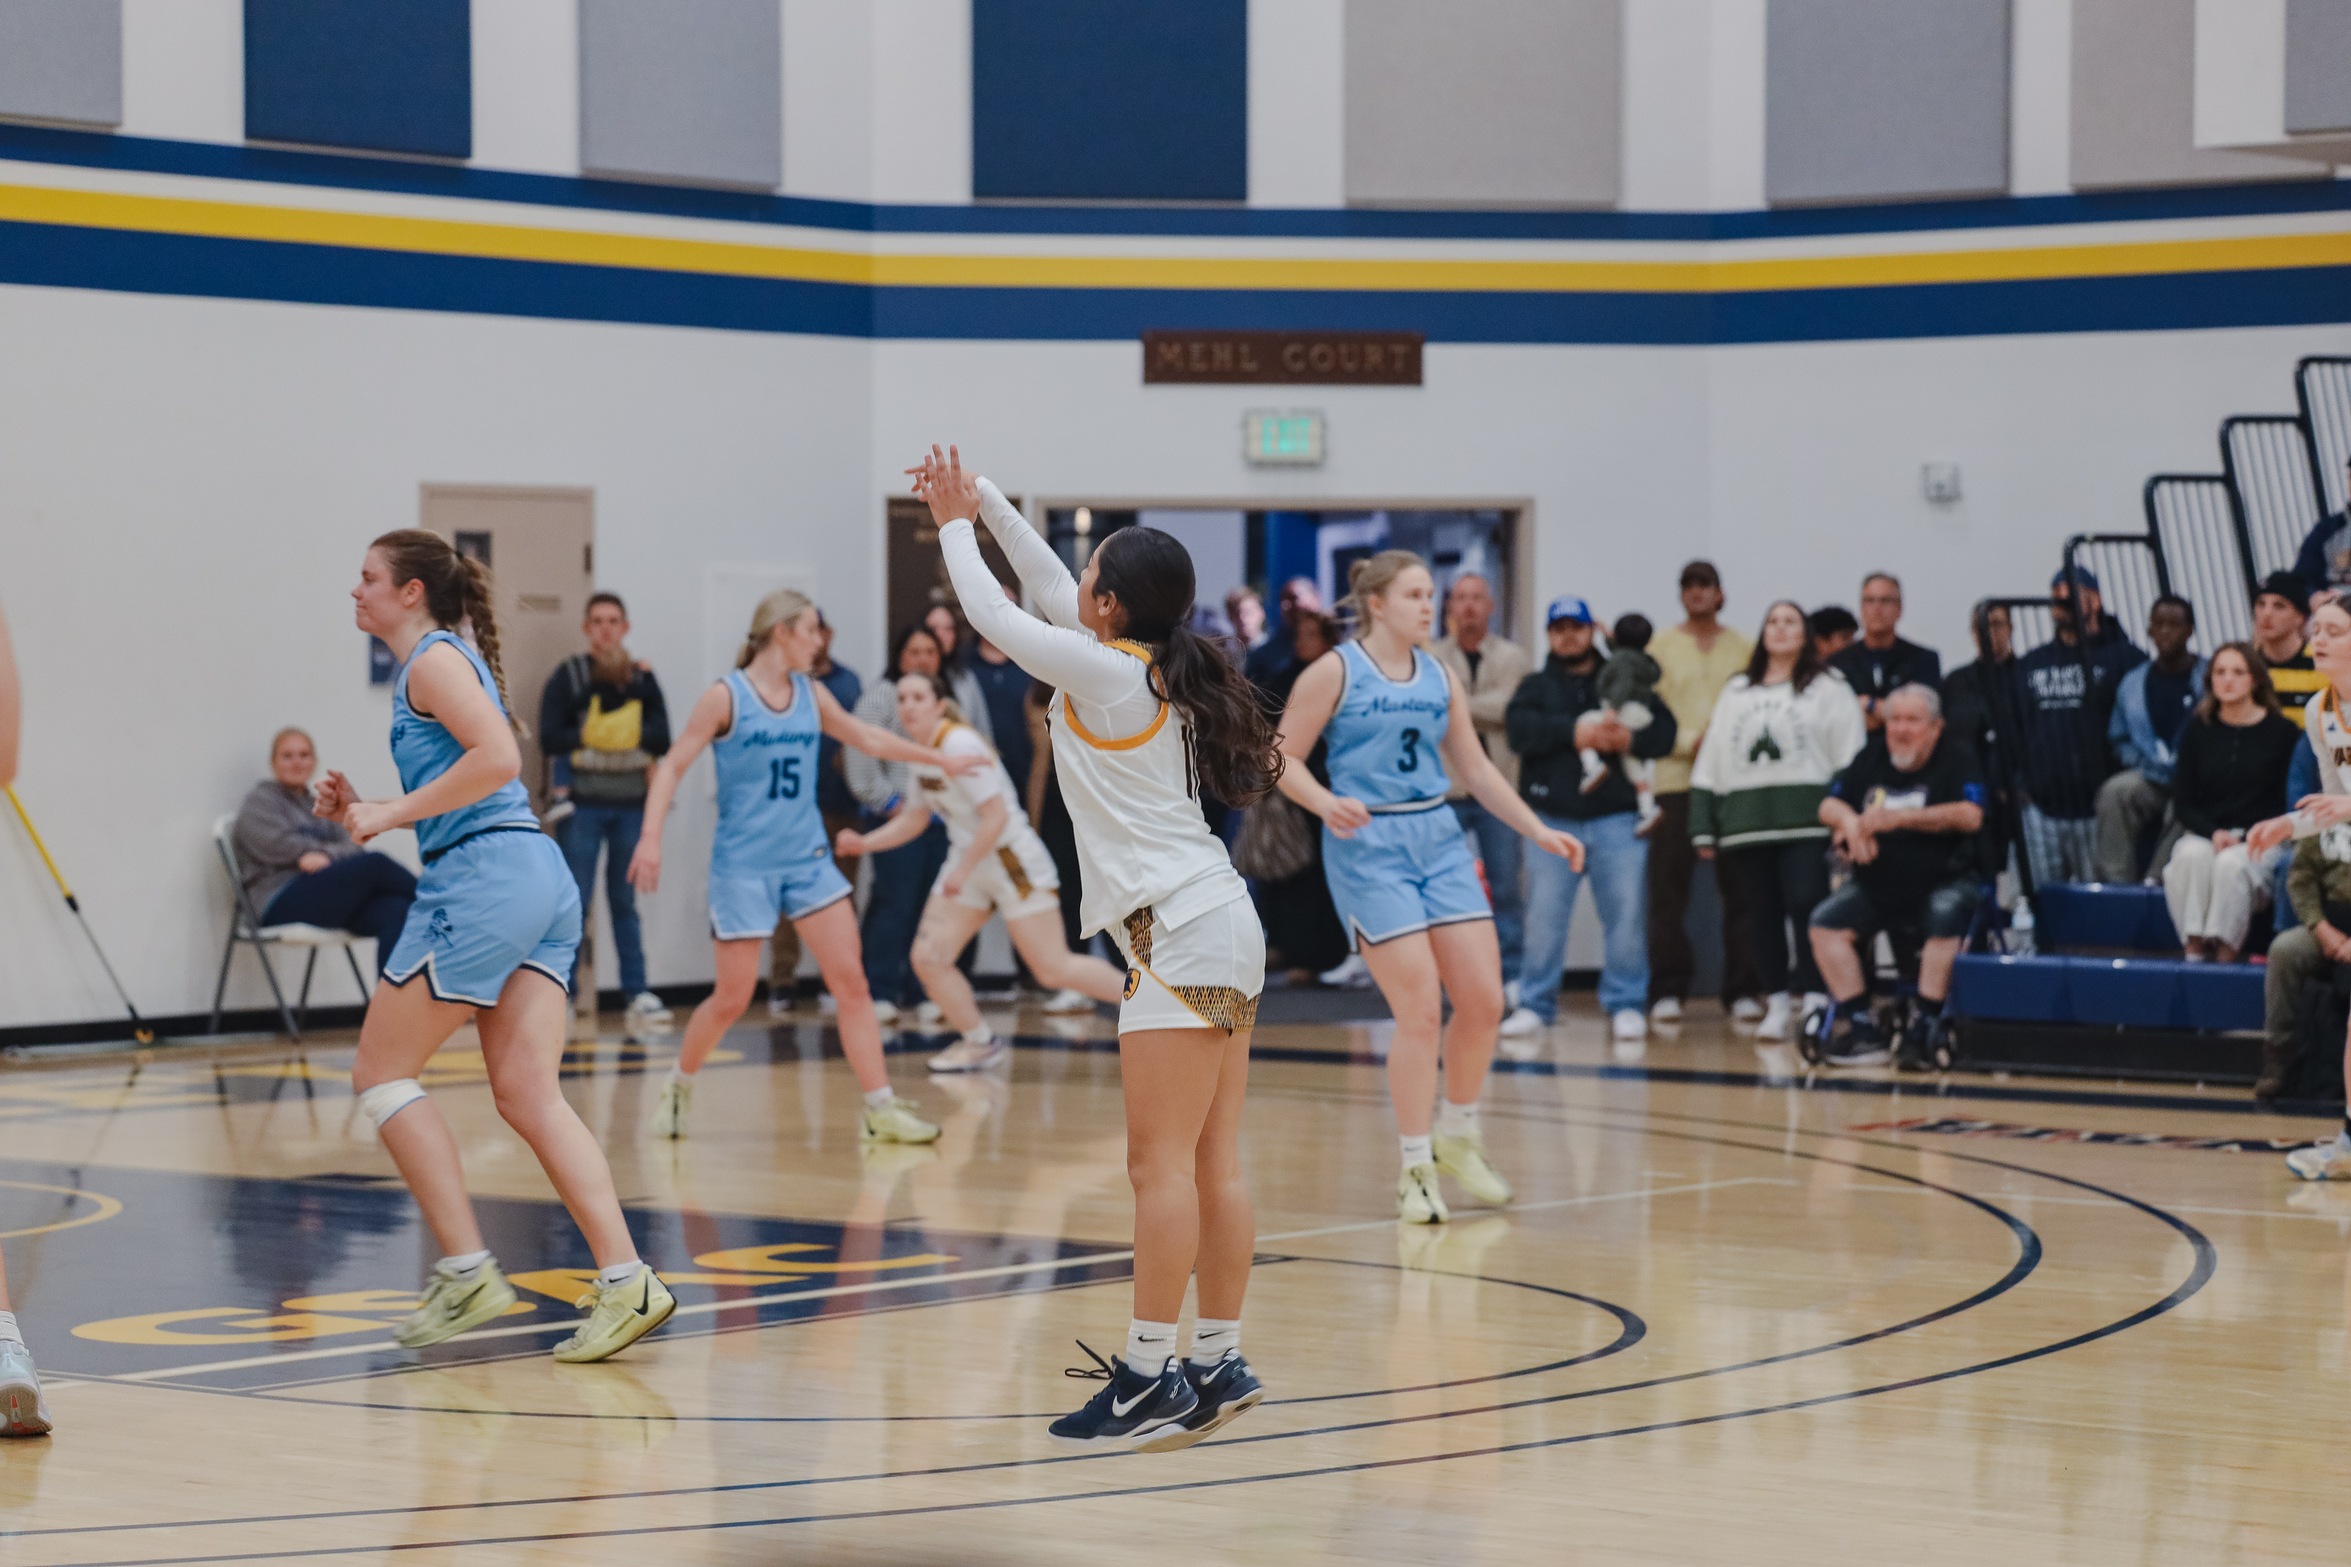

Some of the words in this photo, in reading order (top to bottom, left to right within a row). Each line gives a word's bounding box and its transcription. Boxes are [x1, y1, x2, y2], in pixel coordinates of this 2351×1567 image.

[1281, 341, 1412, 374] COURT
[1398, 727, 1420, 773] 3
[768, 757, 801, 800] 15
